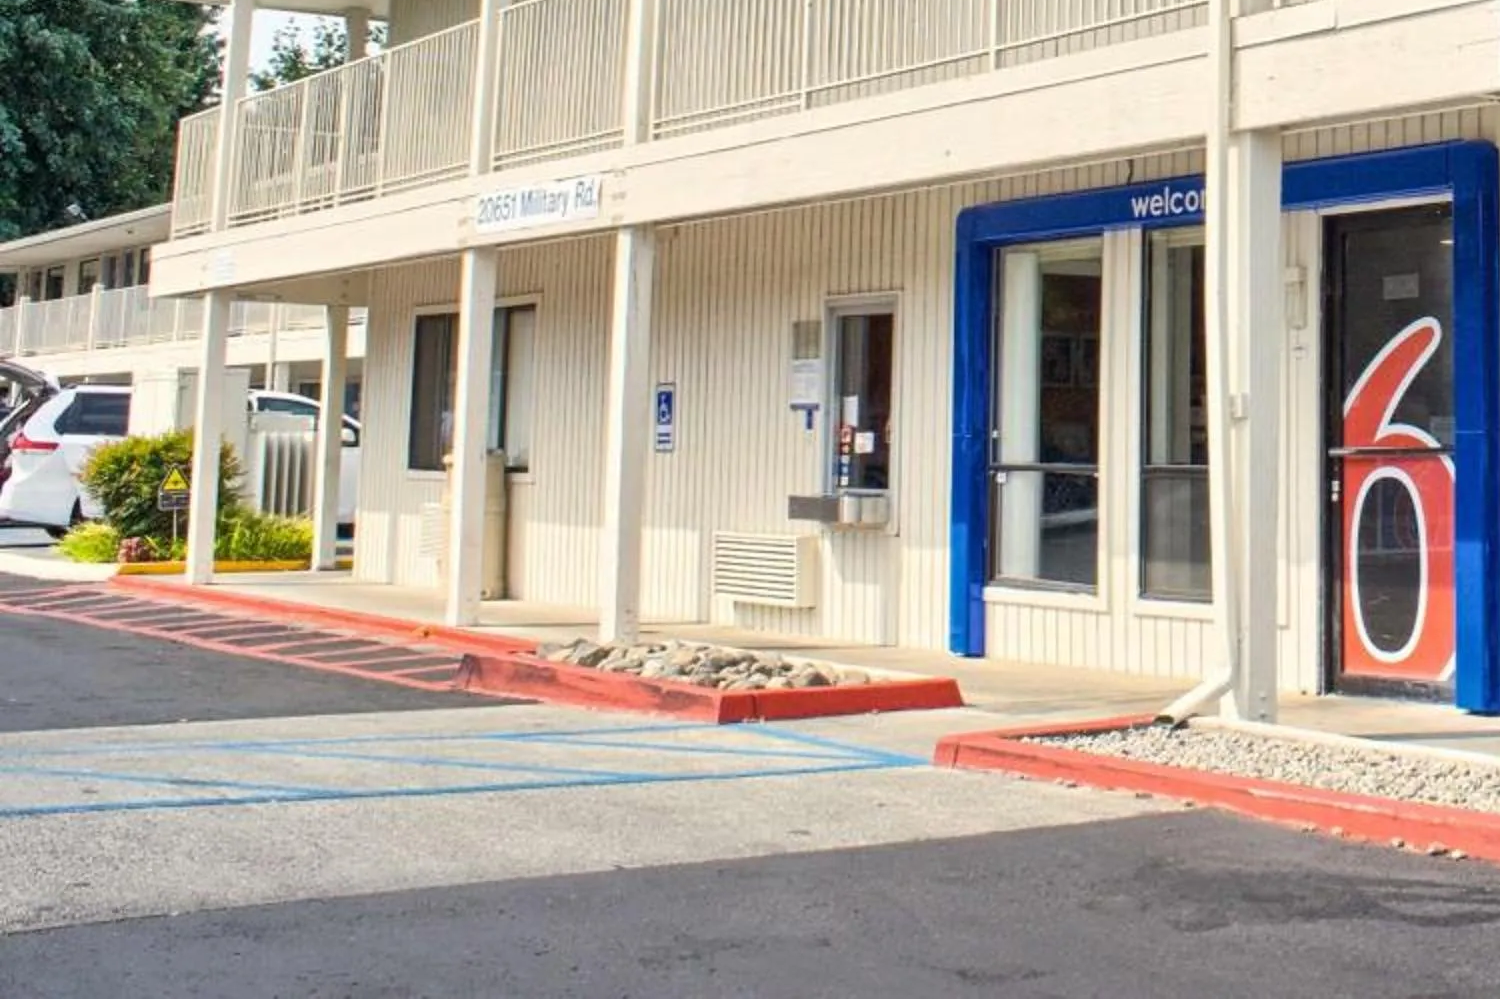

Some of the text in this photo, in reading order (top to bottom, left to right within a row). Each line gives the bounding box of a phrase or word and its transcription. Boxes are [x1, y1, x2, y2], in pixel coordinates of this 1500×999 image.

[477, 192, 517, 224] 20651
[520, 188, 570, 217] Military
[1132, 186, 1206, 217] welco
[1343, 316, 1455, 681] 6
